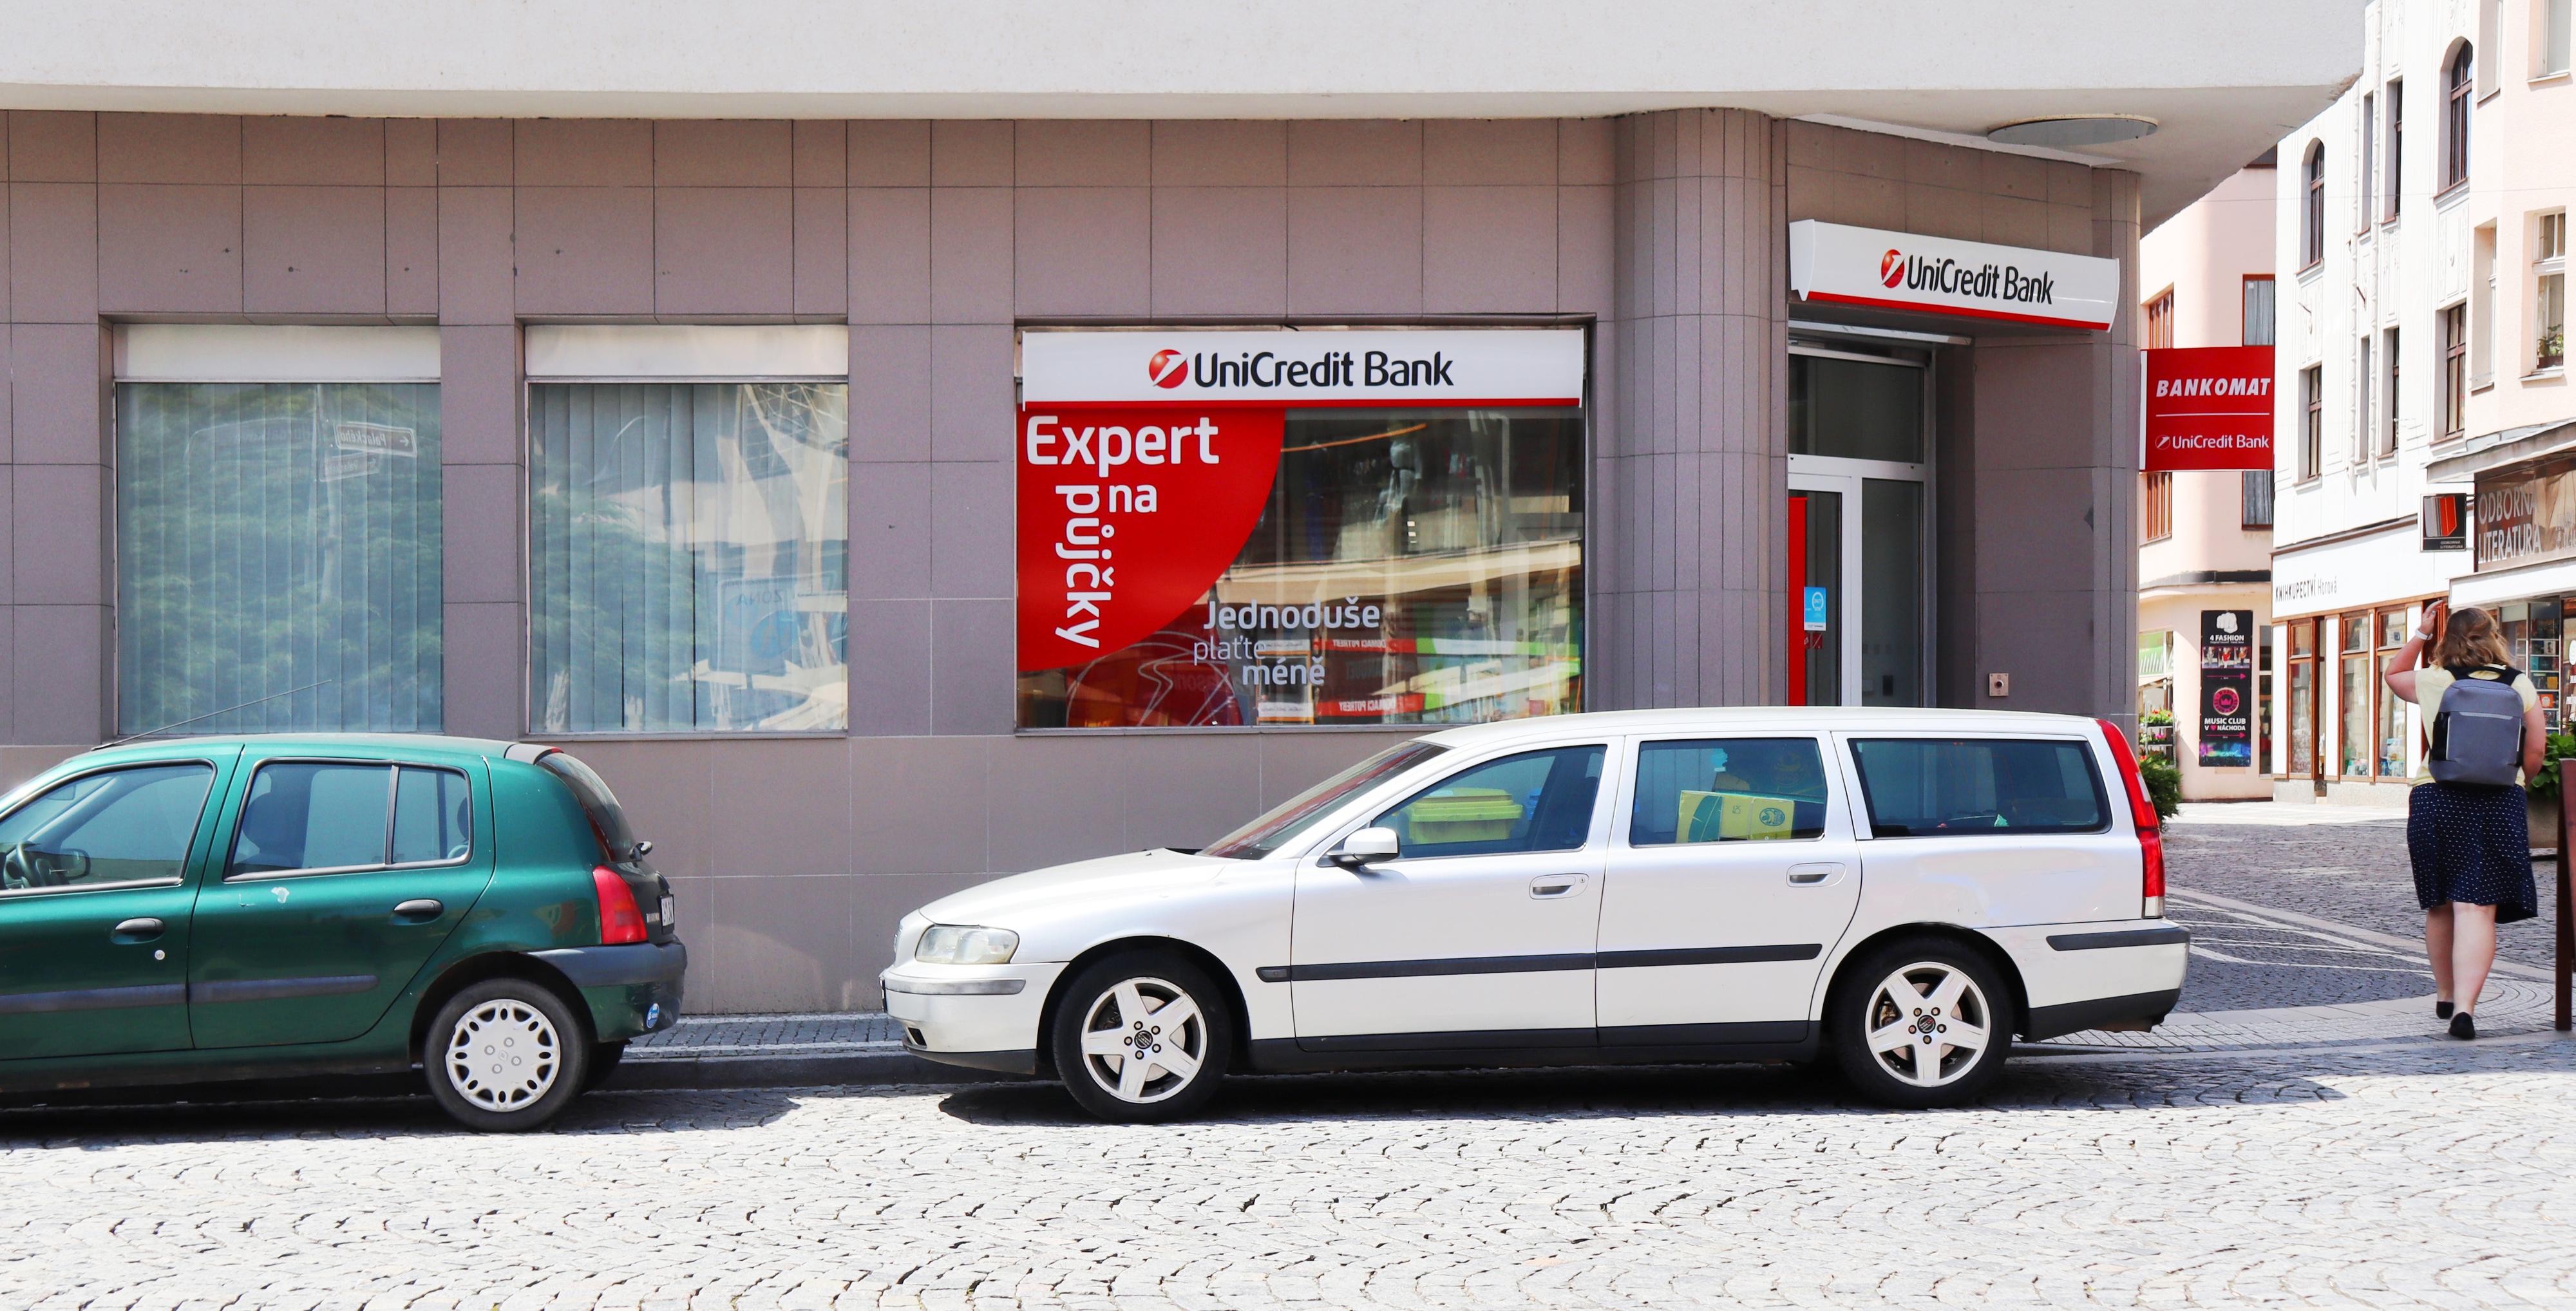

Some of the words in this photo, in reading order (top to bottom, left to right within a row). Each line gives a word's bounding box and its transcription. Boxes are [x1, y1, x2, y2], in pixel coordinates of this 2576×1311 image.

[1907, 254, 2000, 299] UniCredit
[2002, 265, 2054, 305] Bank
[1195, 351, 1354, 388] UniCredit
[1364, 350, 1454, 387] Bank
[2156, 378, 2271, 397] BANKOMAT
[1027, 415, 1219, 478] Expert
[2172, 435, 2233, 449] UniCredit
[2236, 435, 2269, 448] Bank
[1109, 484, 1157, 513] na
[2478, 523, 2542, 564] LITERATURA
[1055, 485, 1114, 648] půjčky
[2275, 573, 2316, 603] KNIHKUPECTVÍ
[2318, 575, 2337, 595] Horová
[1204, 597, 1380, 630] Jednoduše
[1194, 636, 1267, 666] plaťte
[1242, 656, 1325, 686] méně
